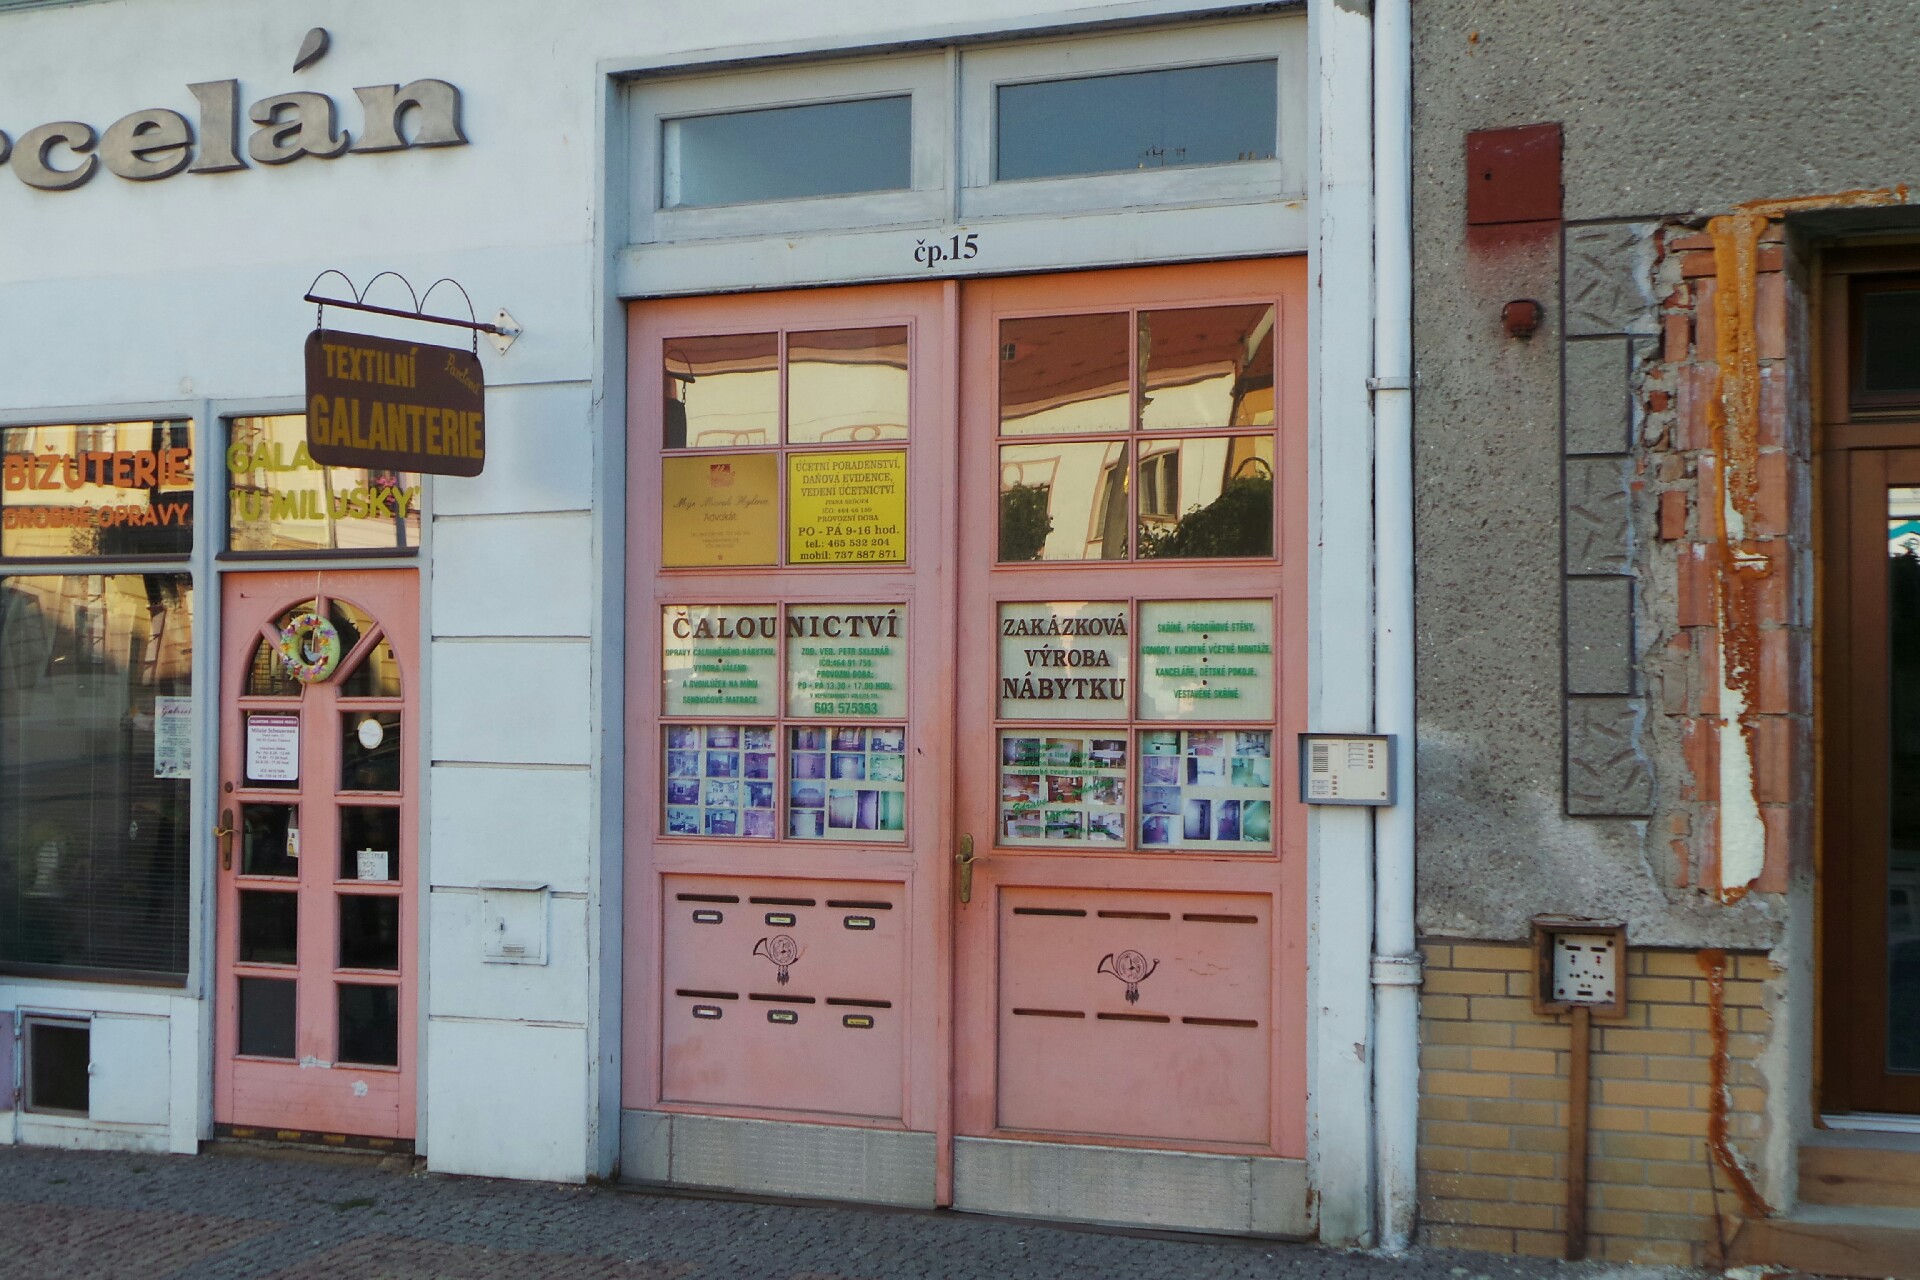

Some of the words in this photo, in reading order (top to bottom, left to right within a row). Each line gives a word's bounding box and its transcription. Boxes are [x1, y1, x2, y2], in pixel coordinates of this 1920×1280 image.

[0, 27, 469, 191] celán
[914, 233, 979, 268] čp.15
[322, 344, 419, 388] TEXTILNÍ
[310, 394, 484, 459] GALANTERIE
[4, 444, 191, 491] BIŽUTERIE
[842, 472, 893, 483] EVIDENCE,
[838, 482, 895, 496] ÚČETNICTVÍ
[4, 500, 94, 530] DROBNÉ
[99, 502, 189, 528] OPRAVY
[817, 513, 856, 523] PROVOZNÍ
[798, 526, 816, 537] PO
[826, 522, 843, 536] PÁ
[845, 526, 871, 536] 9-16
[874, 524, 900, 535] hod.
[805, 540, 825, 549] tel.:
[827, 539, 847, 548] 465
[849, 539, 868, 547] 532
[871, 538, 890, 547] 204
[800, 550, 832, 561] mobil:
[834, 551, 854, 560] 737
[856, 550, 876, 559] 887
[878, 549, 897, 559] 871
[673, 608, 897, 638] ČALOUNICTVÍ
[1003, 612, 1128, 636] ZAKÁZKOVÁ
[665, 648, 691, 657] OPRAVY
[838, 647, 856, 656] PETR
[1024, 643, 1111, 668] VÝROBA
[1199, 665, 1226, 677] DĚTSKÉ
[797, 681, 807, 690] PO
[1002, 671, 1126, 700] NÁBYTKU
[814, 702, 834, 714] 603
[838, 702, 879, 714] 575353
